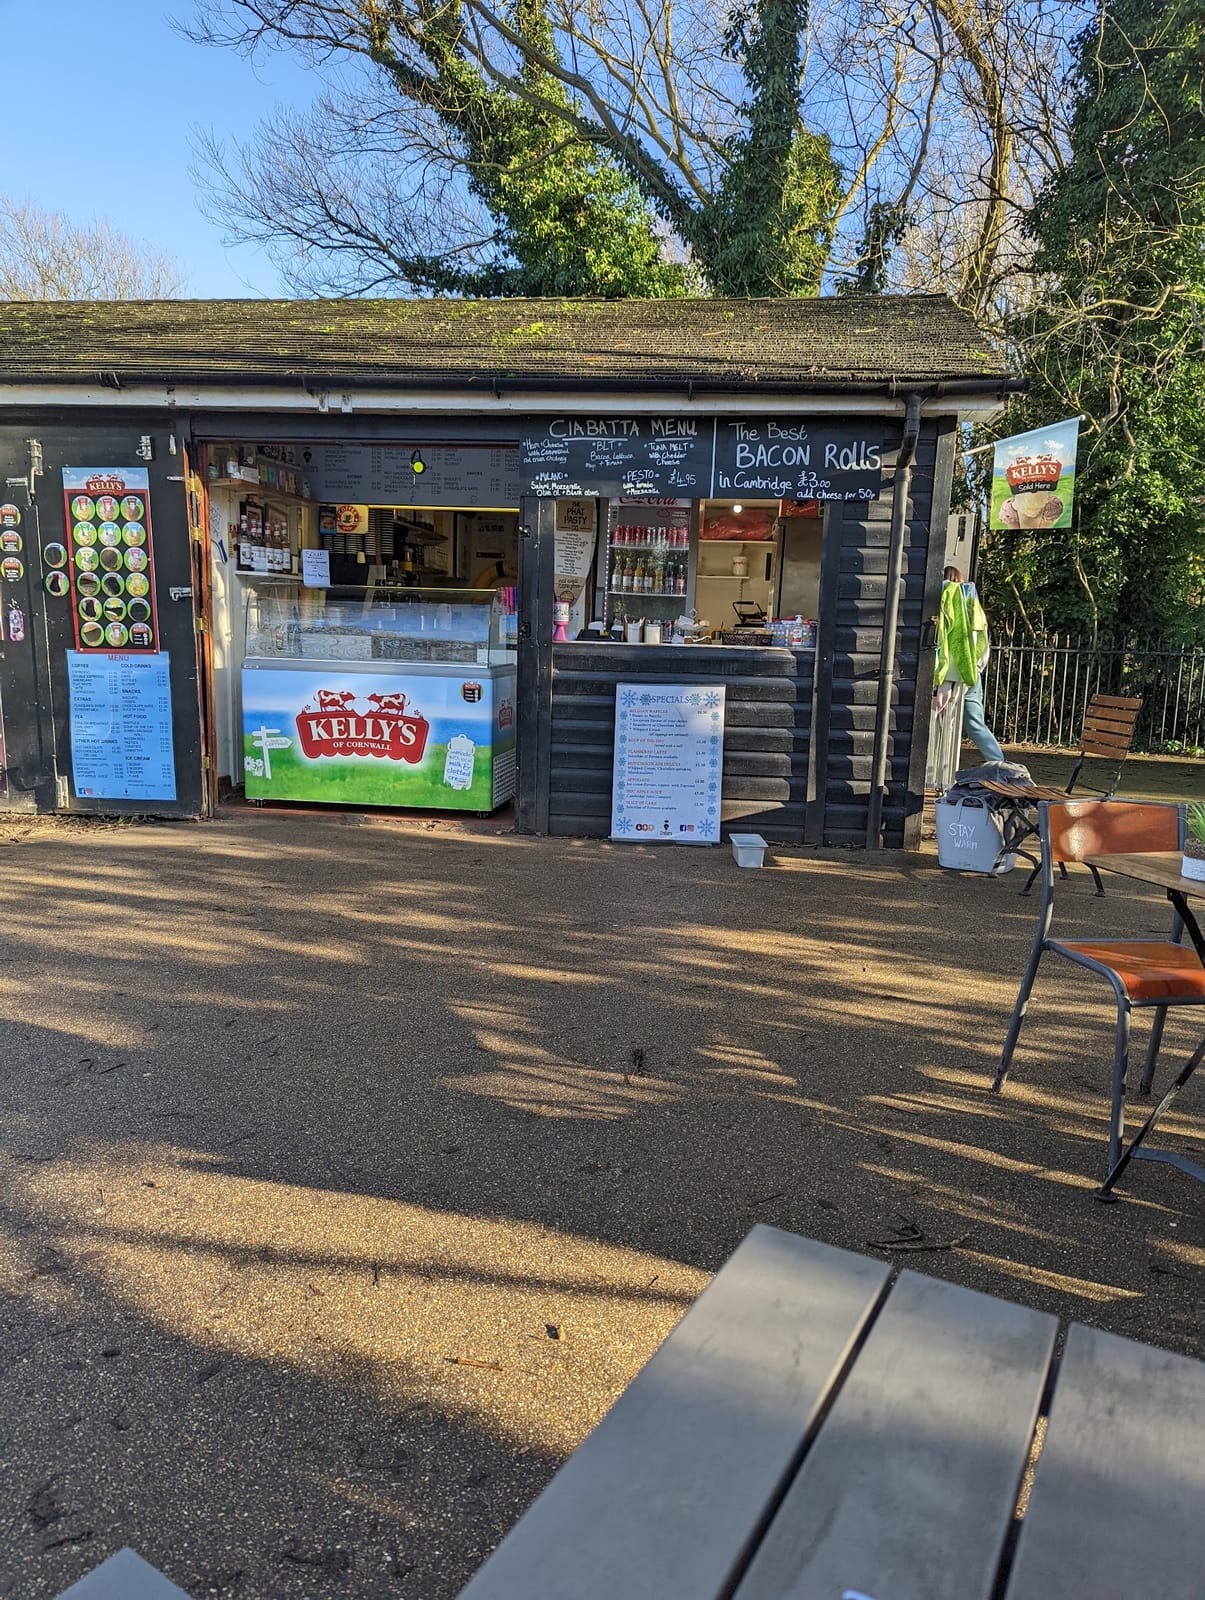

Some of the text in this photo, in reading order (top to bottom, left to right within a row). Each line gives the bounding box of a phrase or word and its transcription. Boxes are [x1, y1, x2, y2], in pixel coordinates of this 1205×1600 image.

[550, 418, 697, 438] CIABATTA MENU
[728, 422, 808, 441] The Best
[596, 441, 614, 450] BLT
[649, 443, 688, 452] TUNA MELT
[736, 444, 810, 468] BACON
[627, 470, 654, 481] PESTO
[1012, 465, 1057, 478] KELLY'S
[90, 482, 122, 491] KELLY'S
[719, 471, 731, 488] in
[734, 471, 792, 497] Cambridge
[1019, 483, 1033, 491] Sold
[797, 488, 875, 500] add cheese for 50p
[564, 516, 587, 525] PASTY
[652, 695, 690, 704] SPECIALS
[308, 717, 417, 746] KELLY'S
[346, 742, 392, 751] CORNWALL
[447, 768, 471, 777] clotted
[948, 822, 975, 838] STAY
